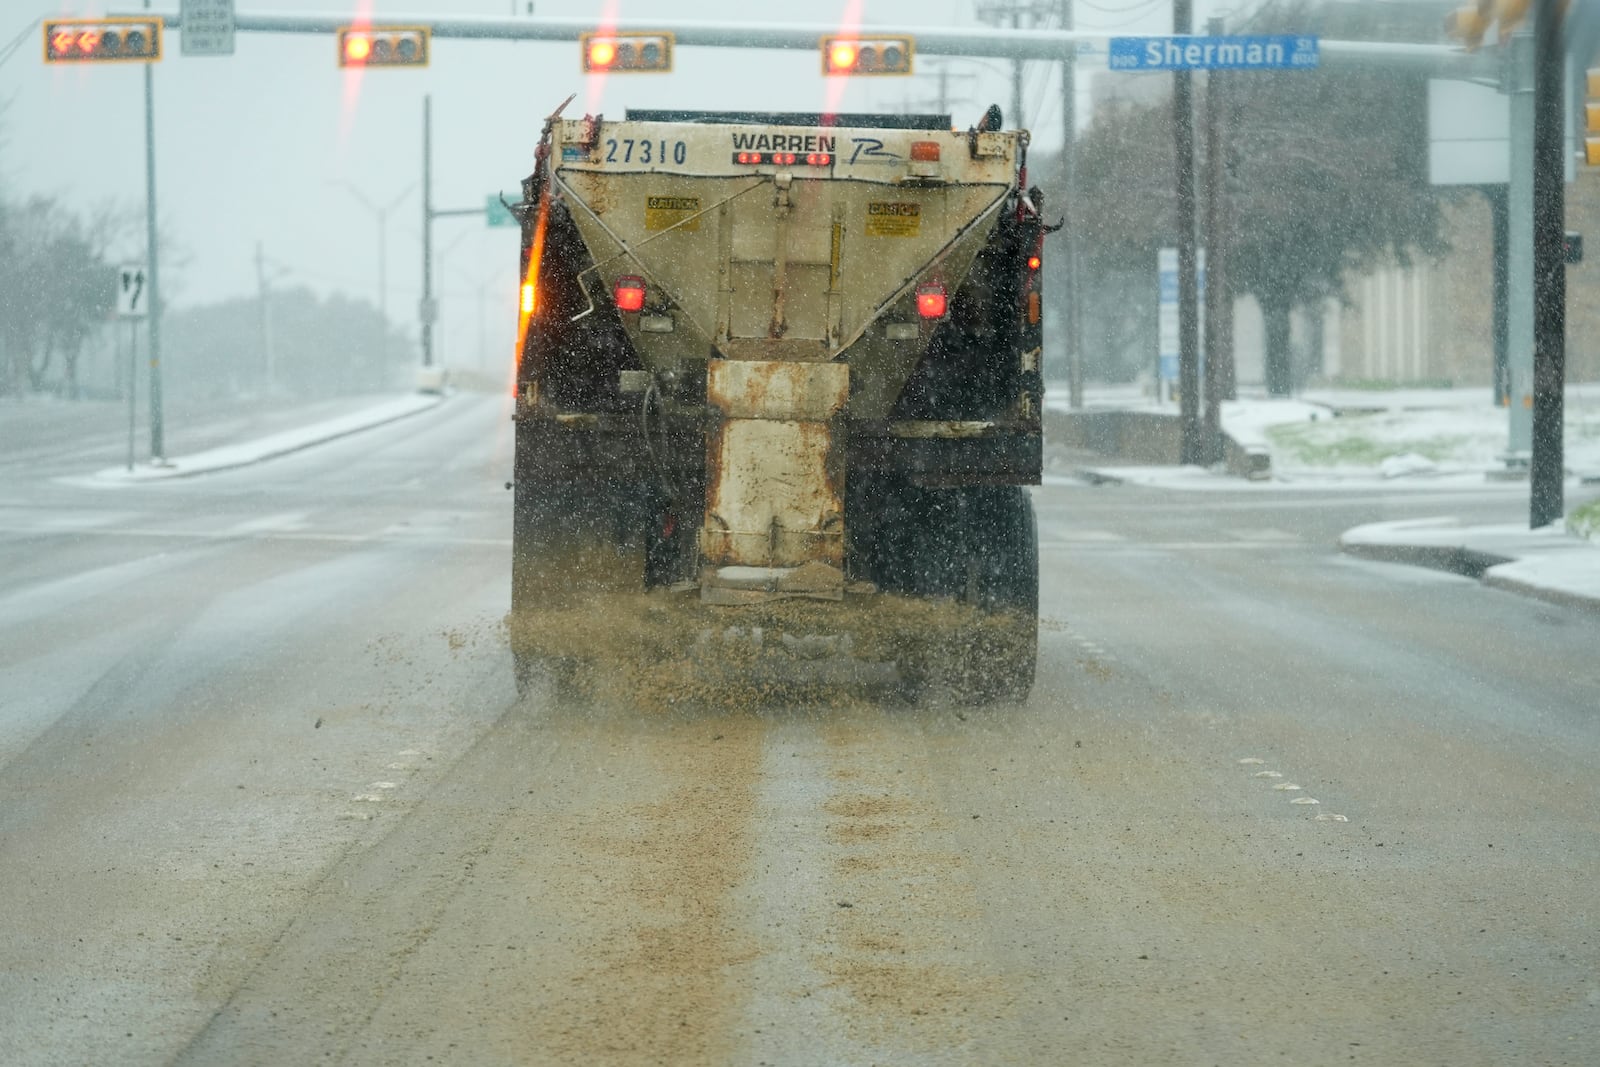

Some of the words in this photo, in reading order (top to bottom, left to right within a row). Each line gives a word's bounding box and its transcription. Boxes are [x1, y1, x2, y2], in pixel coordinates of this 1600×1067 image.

[1146, 40, 1283, 65] Sherman
[606, 139, 687, 165] 27310
[732, 132, 836, 152] WARREN
